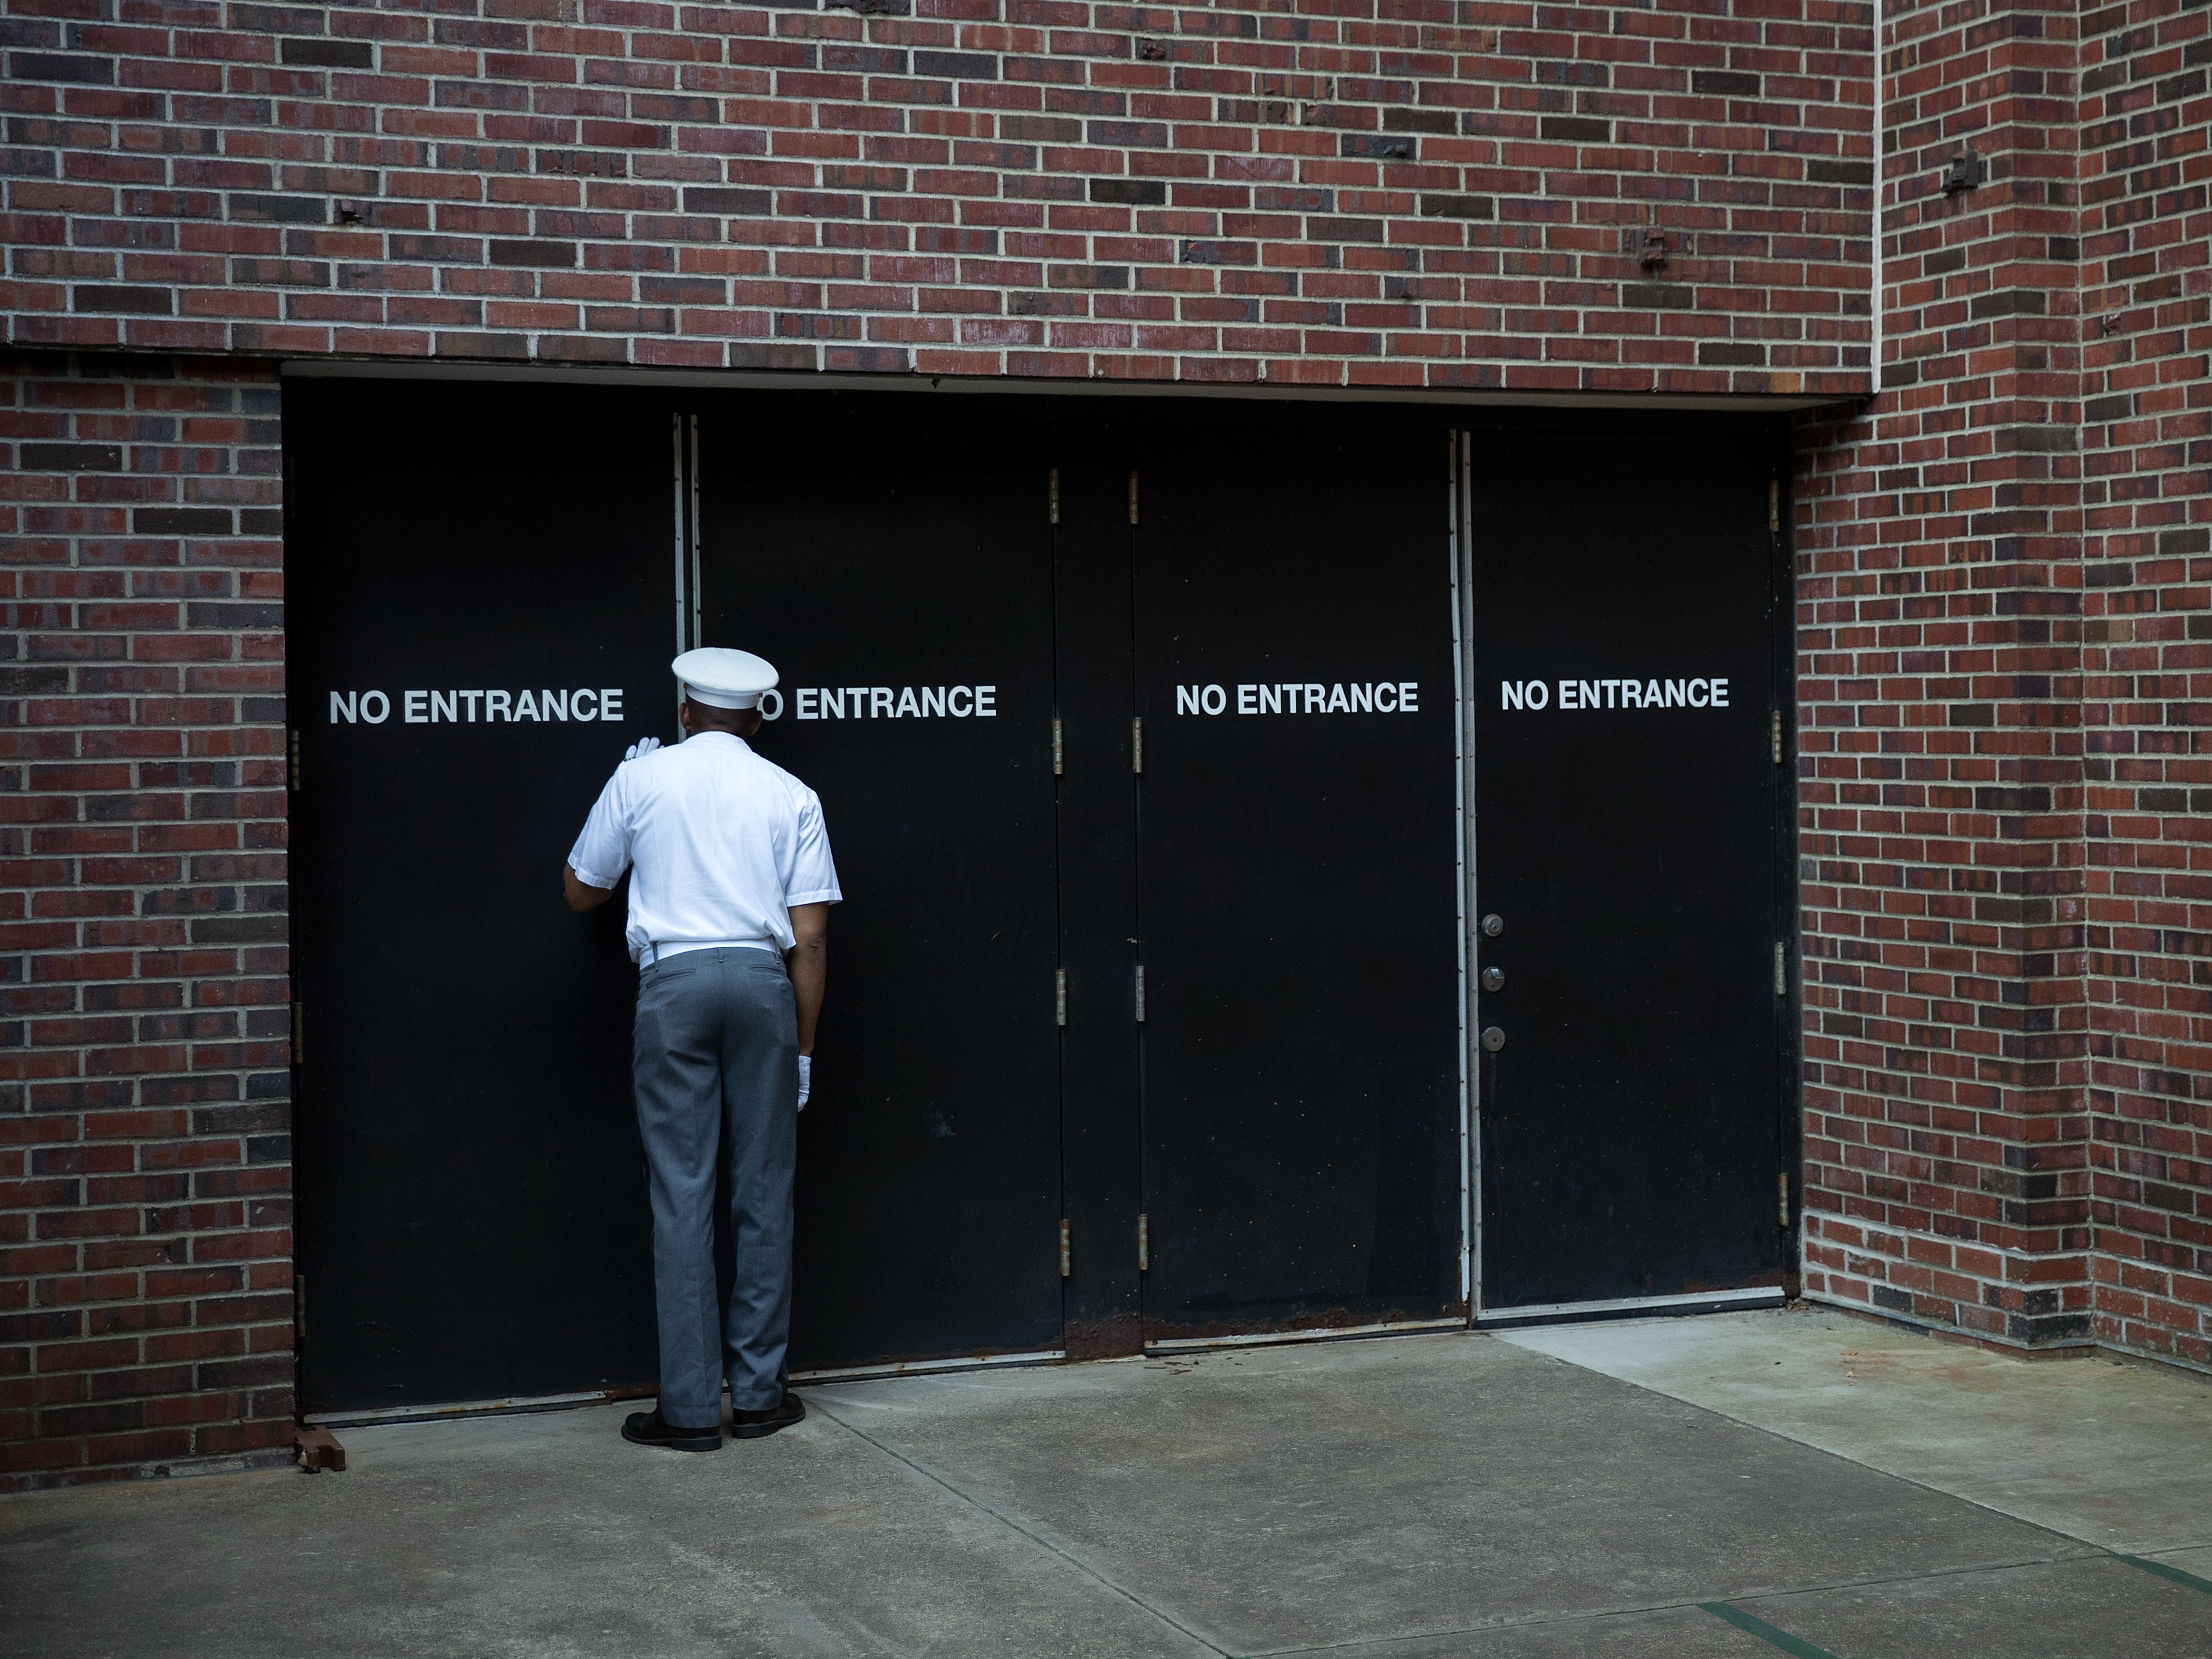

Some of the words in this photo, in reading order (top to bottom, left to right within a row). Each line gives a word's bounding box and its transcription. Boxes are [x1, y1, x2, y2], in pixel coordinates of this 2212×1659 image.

[330, 690, 390, 724] NO
[404, 688, 624, 723] ENTRANCE
[756, 688, 784, 721] O
[797, 685, 996, 720] ENTRANCE
[1177, 684, 1226, 715] NO
[1237, 682, 1419, 714] ENTRANCE
[1502, 680, 1549, 710] NO
[1559, 678, 1729, 709] ENTRANCE
